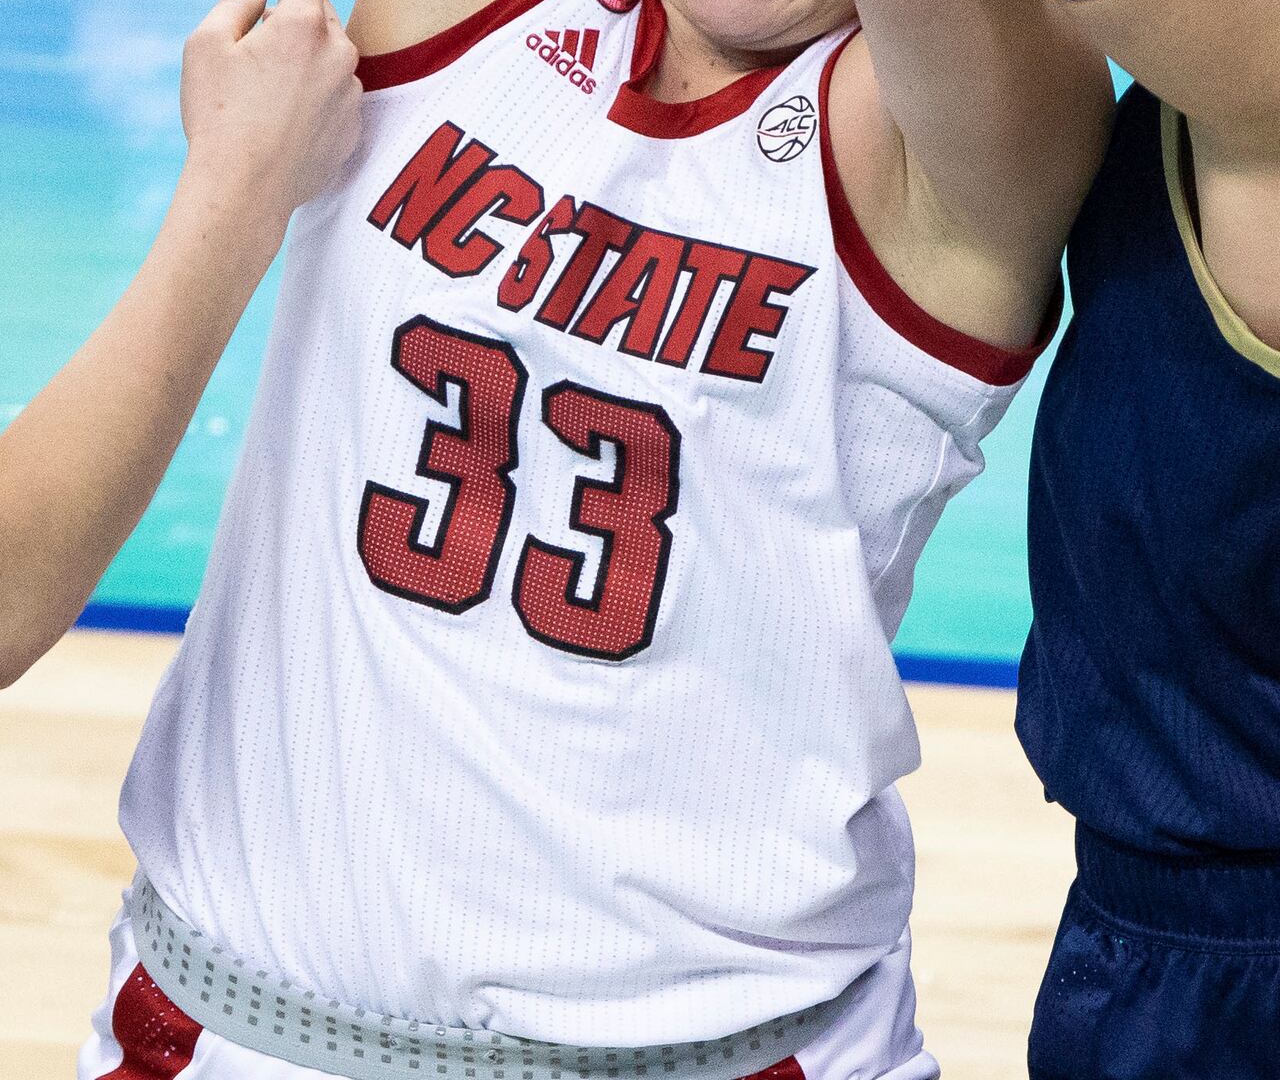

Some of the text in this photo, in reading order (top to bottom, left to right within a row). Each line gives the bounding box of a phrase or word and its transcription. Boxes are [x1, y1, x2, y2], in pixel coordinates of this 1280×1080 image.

[526, 33, 597, 94] adidas
[765, 115, 816, 133] ACC
[367, 120, 818, 383] NC STATE
[357, 313, 682, 662] 33
